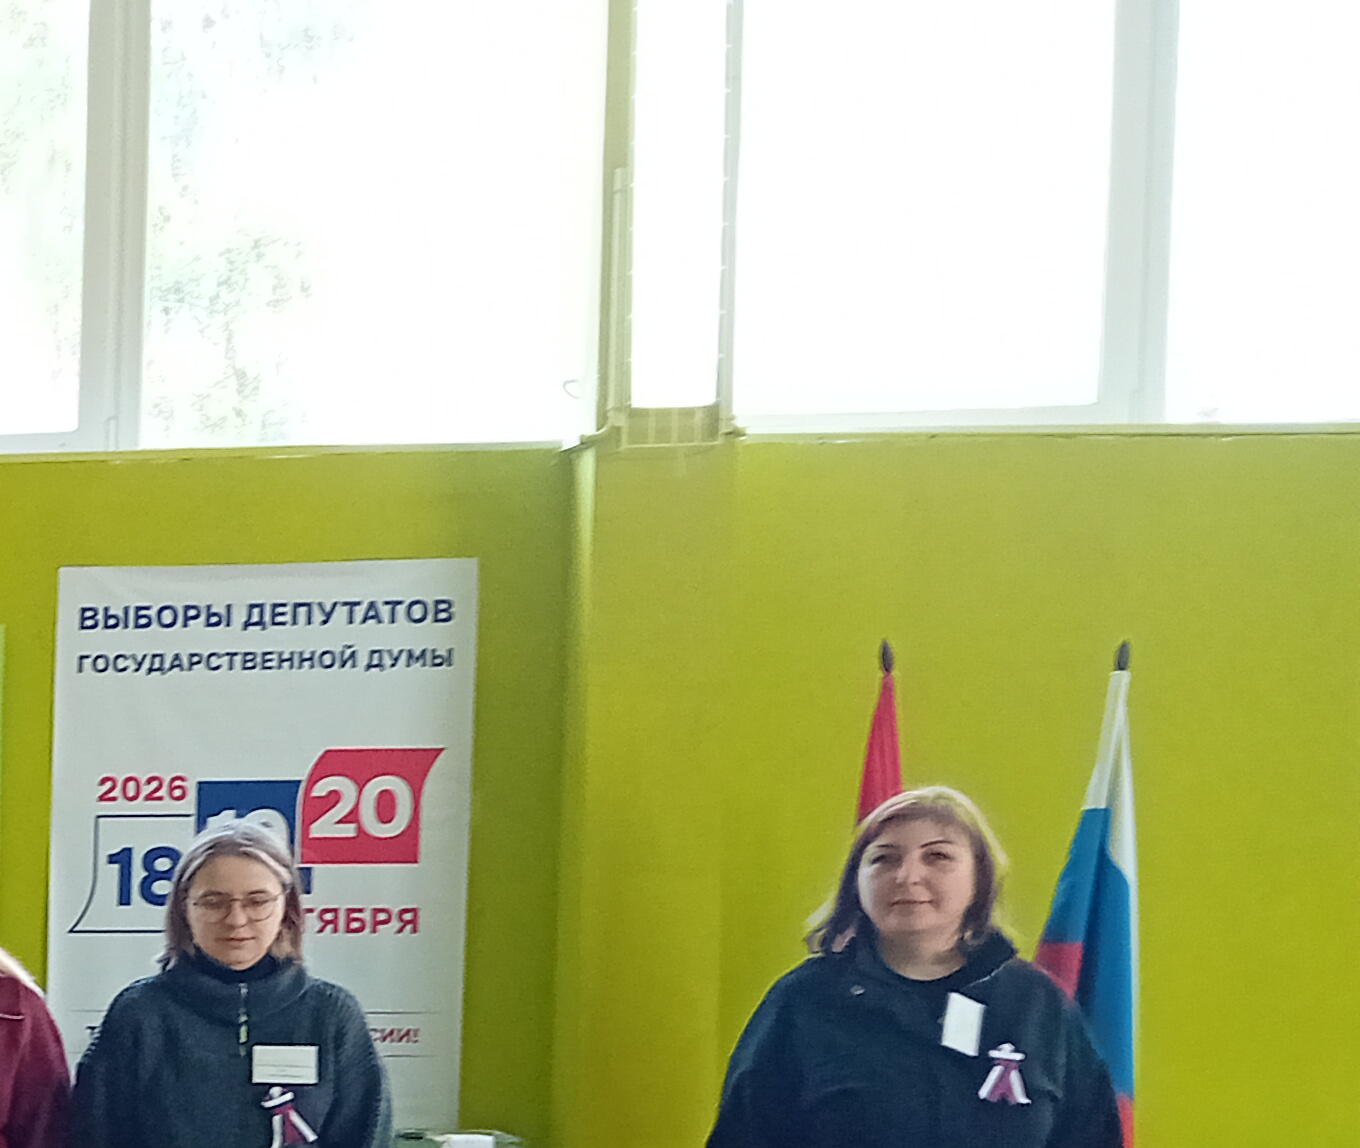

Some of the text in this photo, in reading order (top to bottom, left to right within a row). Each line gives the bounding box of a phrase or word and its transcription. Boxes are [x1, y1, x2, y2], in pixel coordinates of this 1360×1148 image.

[78, 598, 456, 631] ВЫБОРЫ ДЕПУТАТОВ
[76, 643, 455, 676] ГОСУДАРСТВЕННОЙ ДУМЫ
[96, 774, 189, 802] 2026
[307, 774, 415, 839] 20
[106, 845, 181, 907] 18
[300, 906, 421, 935] ТЯБРЯ
